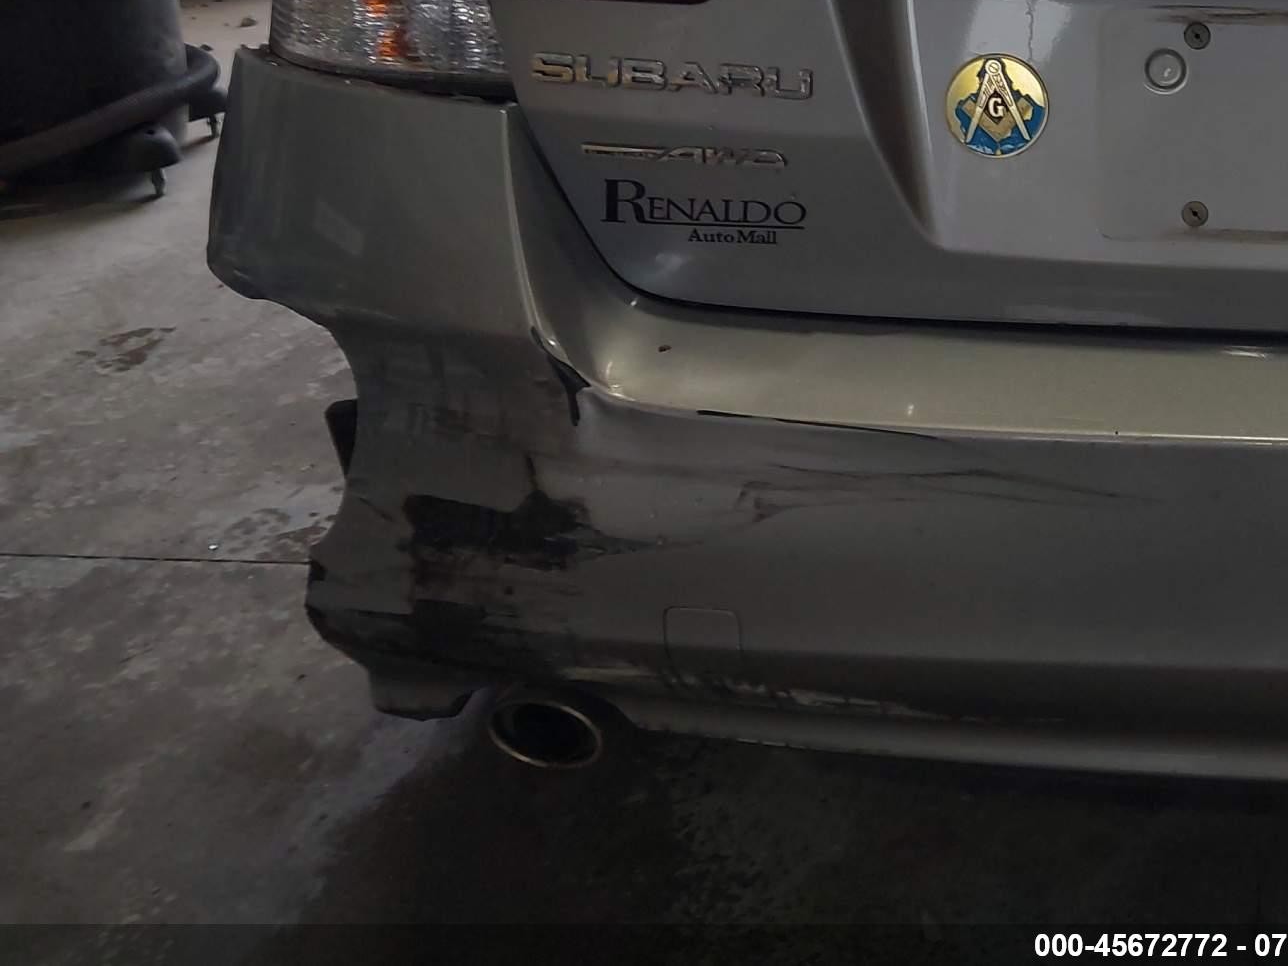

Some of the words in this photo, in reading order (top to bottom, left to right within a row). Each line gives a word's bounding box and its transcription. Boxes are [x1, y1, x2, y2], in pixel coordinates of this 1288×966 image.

[531, 52, 813, 100] SUBARU
[988, 97, 1005, 118] G
[602, 178, 807, 226] RENALDO
